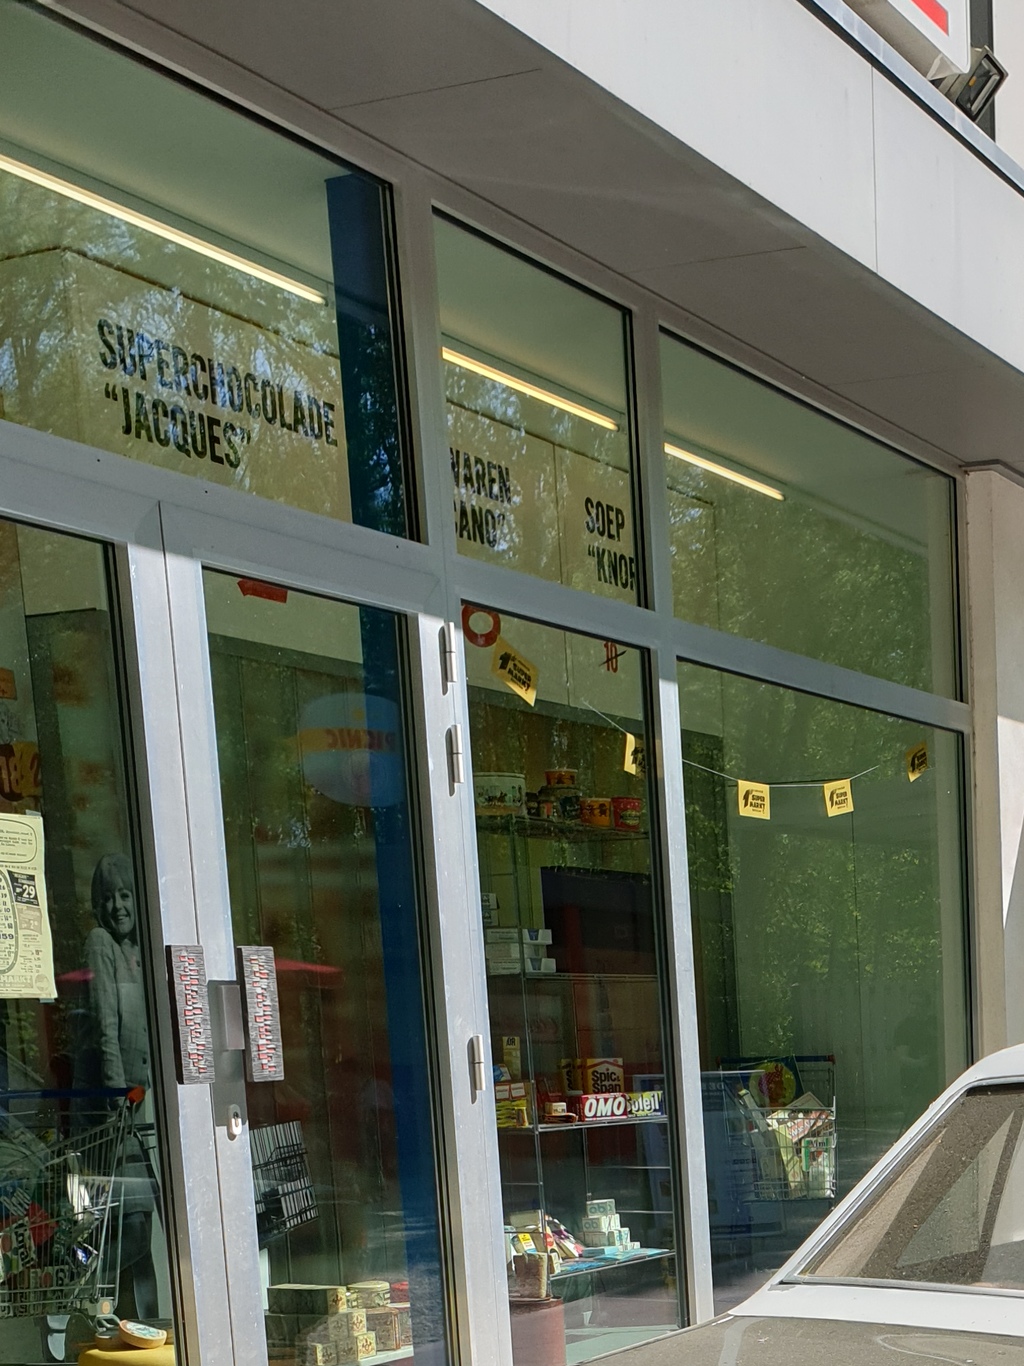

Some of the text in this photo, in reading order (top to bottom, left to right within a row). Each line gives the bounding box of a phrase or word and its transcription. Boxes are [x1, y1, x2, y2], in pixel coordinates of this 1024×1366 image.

[97, 318, 337, 447] SUPERCHOCOLADE
[584, 496, 625, 542] SOEP
[22, 884, 35, 898] 29
[591, 1068, 616, 1084] Spic
[592, 1083, 621, 1093] Span
[584, 1097, 626, 1117] OMO
